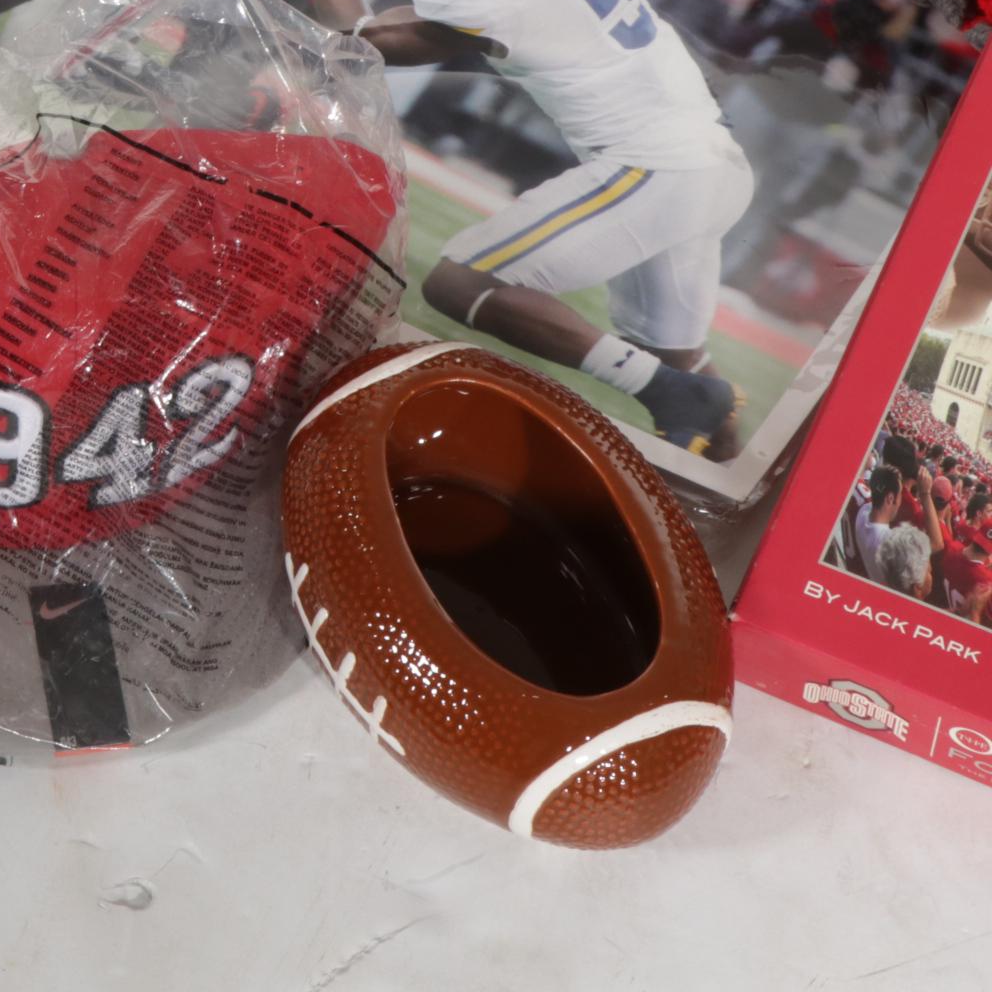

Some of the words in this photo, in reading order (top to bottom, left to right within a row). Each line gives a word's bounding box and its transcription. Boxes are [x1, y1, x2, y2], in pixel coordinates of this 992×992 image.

[803, 581, 841, 604] BY
[844, 600, 909, 635] JACK
[913, 625, 982, 664] PARK
